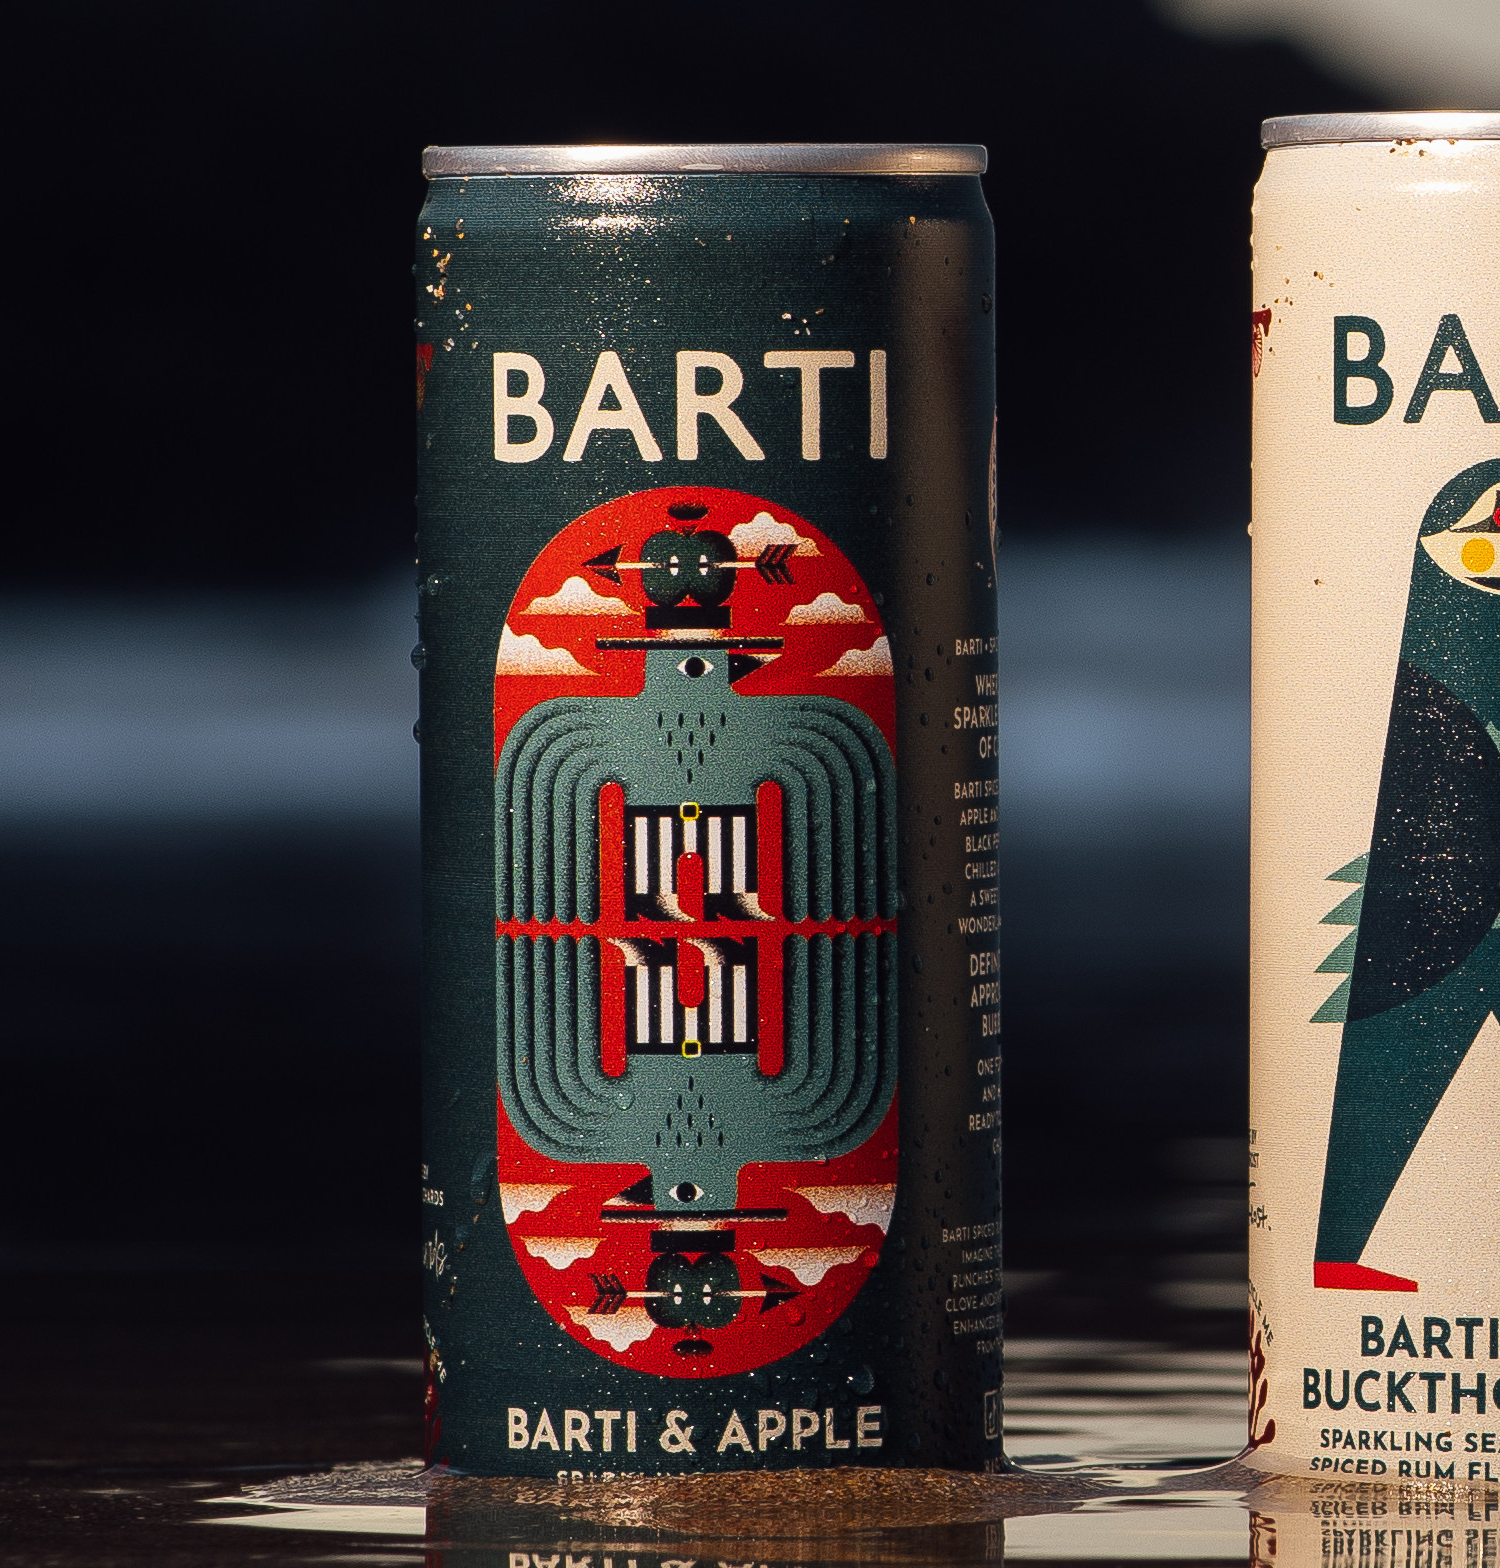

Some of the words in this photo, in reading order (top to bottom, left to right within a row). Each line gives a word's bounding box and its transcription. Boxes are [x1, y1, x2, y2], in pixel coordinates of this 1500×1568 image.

[493, 349, 888, 463] BARTI
[955, 638, 983, 656] BARTI
[1361, 1315, 1500, 1360] BARTI
[508, 1407, 637, 1453] BARTI
[659, 1409, 696, 1453] &
[717, 1405, 883, 1453] APPLE
[1320, 1428, 1453, 1453] SPARKLING
[1309, 1456, 1388, 1476] SPICED
[1398, 1459, 1455, 1480] RUM
